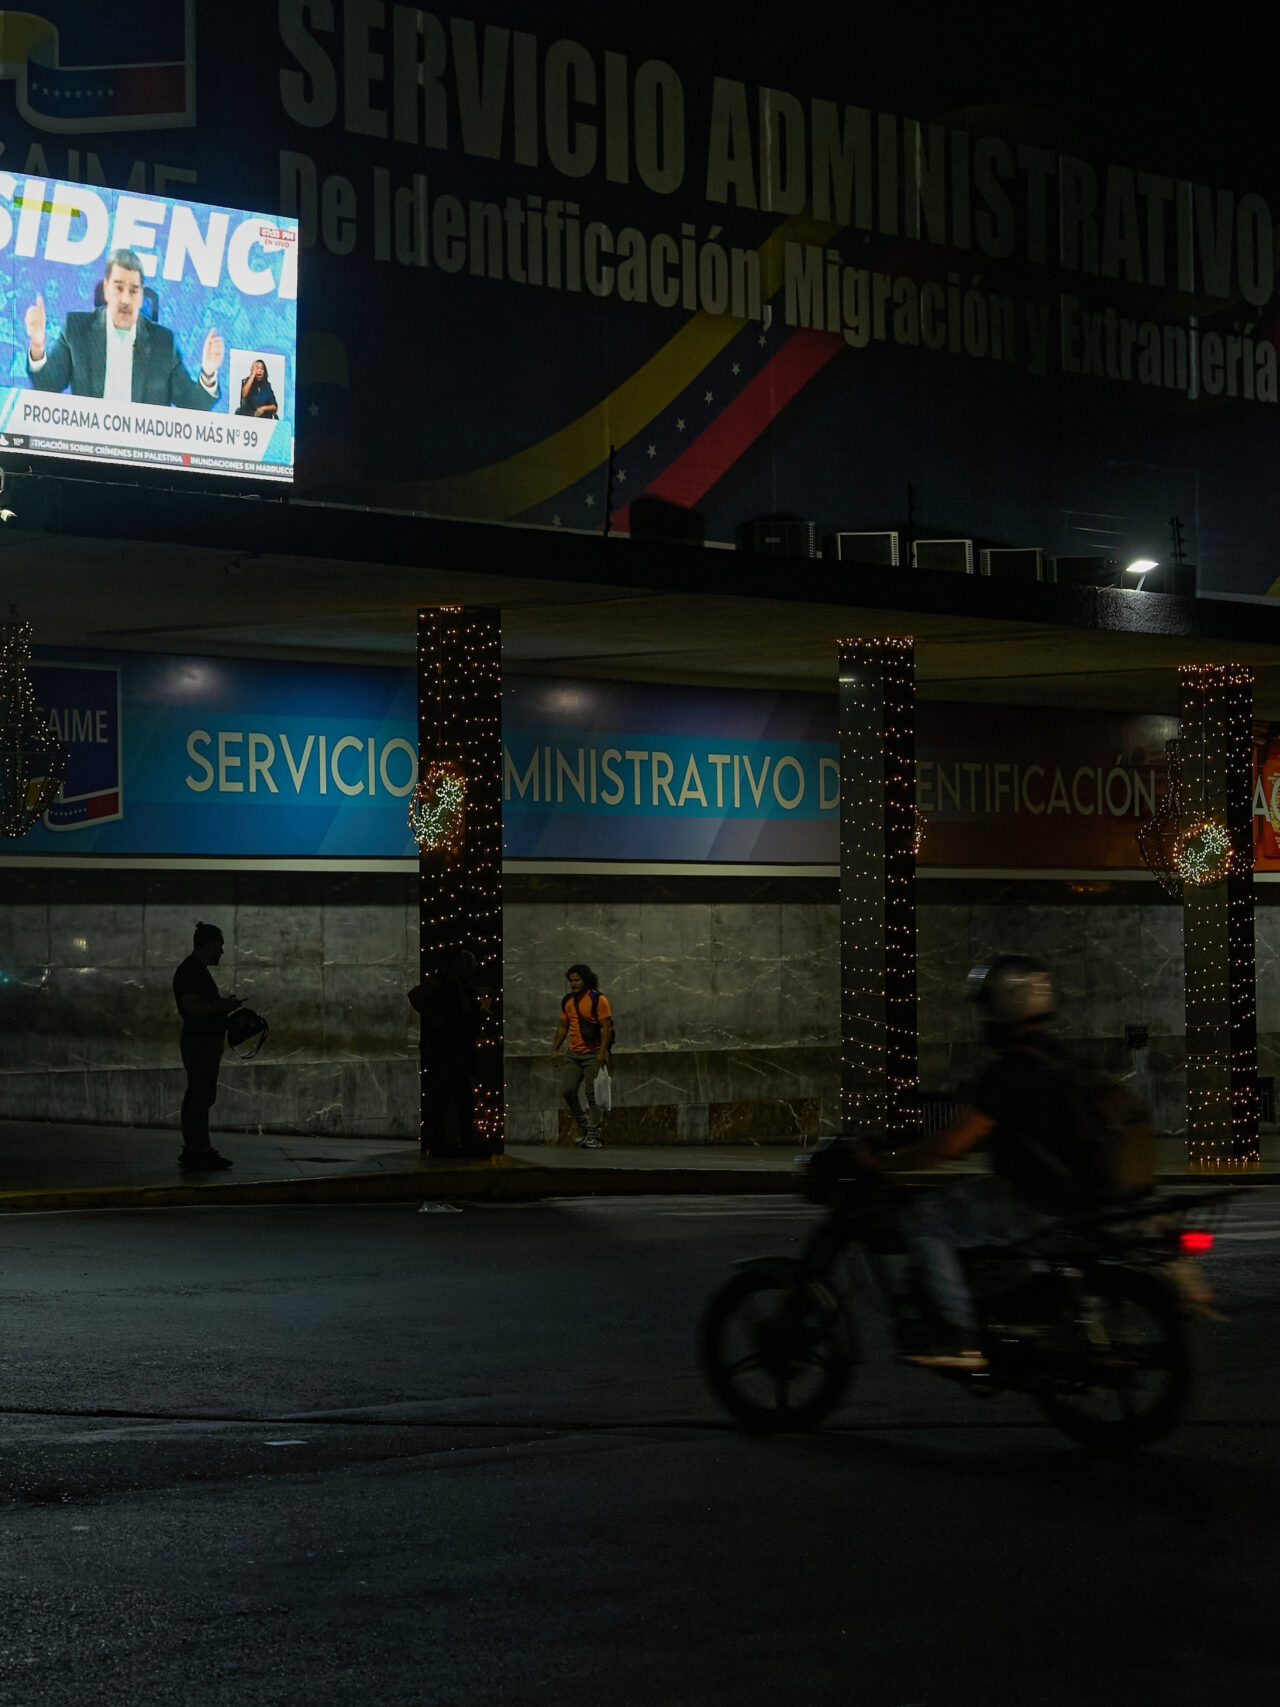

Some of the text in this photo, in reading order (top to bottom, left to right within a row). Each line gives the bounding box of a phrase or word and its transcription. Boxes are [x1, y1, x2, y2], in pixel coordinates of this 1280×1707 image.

[279, 0, 1276, 307] SERVICIO ADMINISTRATIVO
[279, 149, 1280, 405] De Identificación, Migración y Extranjería
[23, 404, 100, 430] PROGRAMA
[103, 413, 131, 434] CON
[134, 417, 193, 440] MADURO
[195, 421, 223, 444] MÁS
[243, 430, 258, 448] 99
[30, 438, 183, 463] TIGACIÓN SOBRE CRÍMENES EN PALESTINA
[190, 457, 244, 470] INUNDACIONES
[244, 461, 255, 470] EN
[185, 729, 419, 798] SERVICIO
[501, 744, 806, 811] MINISTRATIVO
[820, 757, 841, 810] D
[915, 755, 1156, 817] ENTIFICACIÓN
